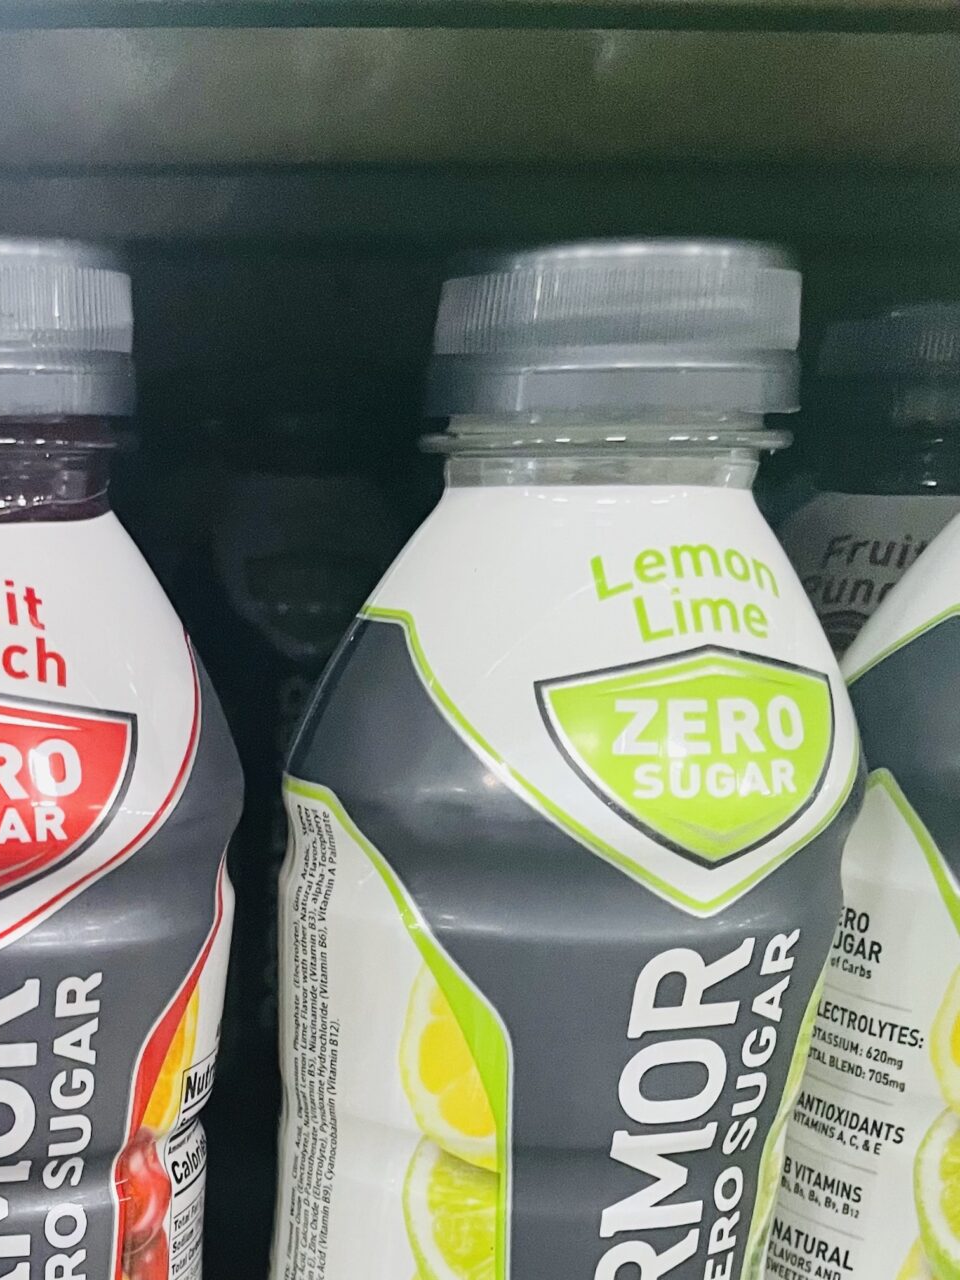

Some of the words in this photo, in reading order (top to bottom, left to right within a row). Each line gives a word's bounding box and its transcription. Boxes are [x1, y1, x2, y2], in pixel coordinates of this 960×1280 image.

[590, 544, 780, 601] Lemon
[633, 588, 768, 642] Lime
[612, 695, 805, 758] ZERO
[633, 759, 797, 799] SUGAR
[841, 958, 872, 980] Carbs
[723, 927, 800, 1152] SUGAR
[813, 1025, 863, 1058] OTASSIUM:
[865, 1046, 904, 1070] 620mg
[817, 999, 924, 1049] LECTROLYTES:
[43, 972, 103, 1187] SUGAR
[828, 1053, 866, 1079] BLEND:
[868, 1069, 906, 1092] 705mg
[793, 1112, 835, 1139] VITAMINS
[873, 1142, 882, 1156] E
[797, 1091, 906, 1144] ANTIOXIDANTS
[783, 1156, 791, 1174] B
[794, 1160, 864, 1204] VITAMINS
[768, 1241, 813, 1273] FLAVORS
[771, 1217, 854, 1271] NATURAL
